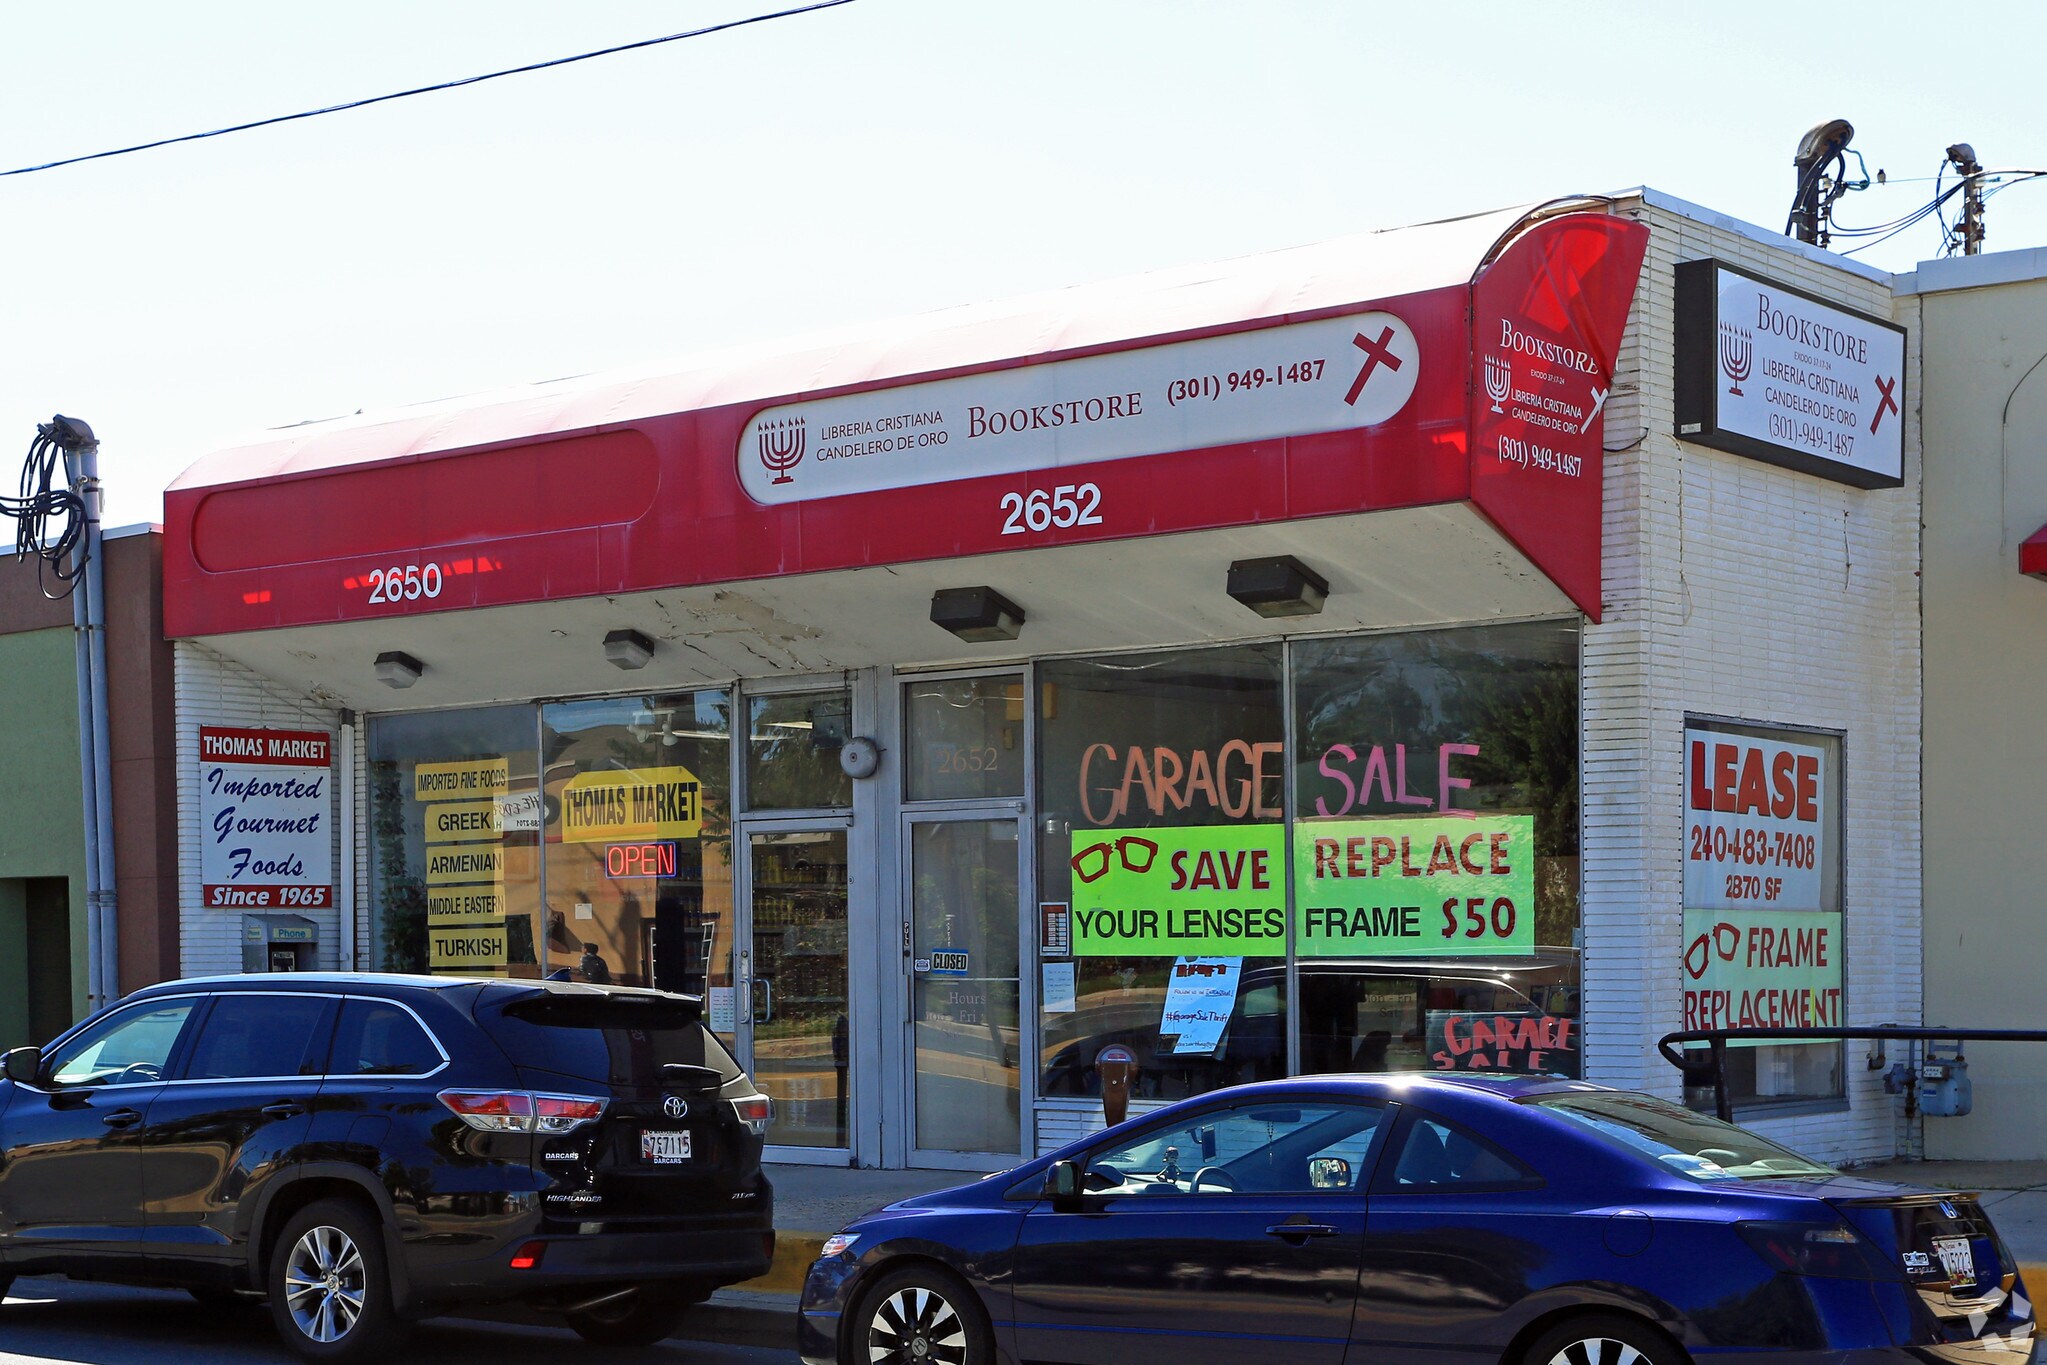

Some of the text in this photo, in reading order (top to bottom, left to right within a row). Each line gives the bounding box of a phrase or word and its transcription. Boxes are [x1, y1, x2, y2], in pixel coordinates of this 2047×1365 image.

[1500, 318, 1599, 375] BOOKSTORE
[1757, 292, 1868, 365] BOOKSTORE
[1167, 359, 1325, 406] (301) 949-1487
[1762, 357, 1860, 404] LIBRERIA CRISTIANA
[967, 392, 1143, 438] BOOKSTORE
[1511, 387, 1583, 419] LIBRERIA CRISTIANA
[1511, 407, 1578, 435] CANDELERO DE ORO
[1765, 386, 1857, 428] CANDELERO DE ORO
[821, 410, 943, 440] LIBRERIA CRISTIANA
[1768, 413, 1855, 458] (301)-949-1487
[816, 430, 949, 461] CANDELERO DE ORO
[1498, 434, 1582, 478] (301) 949-1487
[999, 482, 1103, 535] 2652
[367, 562, 443, 605] 2650
[203, 735, 327, 759] THOMAS MARKET
[938, 746, 999, 774] 2652
[207, 767, 324, 803] Imported
[418, 768, 506, 792] IMPORTED FINE FOODS
[1079, 738, 1481, 826] GARAGE SALE
[1691, 740, 1819, 822] LEASE
[437, 811, 491, 832] GREEK
[564, 781, 698, 827] THOMAS MARKET
[213, 806, 320, 844] Gourmet
[228, 848, 304, 880] Foods
[430, 853, 502, 874] ARMENIAN
[607, 844, 673, 876] OPEN
[1315, 832, 1511, 879] REPLACE
[1690, 824, 1815, 870] 240-483-7408
[1170, 849, 1270, 891] SAVE
[1725, 874, 1782, 900] 2870 SF
[211, 886, 326, 906] Since 1965
[429, 894, 504, 915] MIDDLE EASTERN
[278, 928, 306, 939] Phone
[1075, 909, 1159, 939] YOUR
[1167, 907, 1285, 939] LENSES
[1306, 896, 1517, 939] FRAME $50
[435, 937, 502, 957] TURKISH
[933, 953, 967, 969] CLOSED
[1746, 927, 1828, 968] FRAME
[949, 991, 986, 1005] Hours
[1684, 988, 1840, 1031] REPLACEMENT
[1443, 1015, 1575, 1056] GARAGE
[545, 1152, 579, 1160] DARCARS
[546, 1194, 602, 1203] HIGHLANDER
